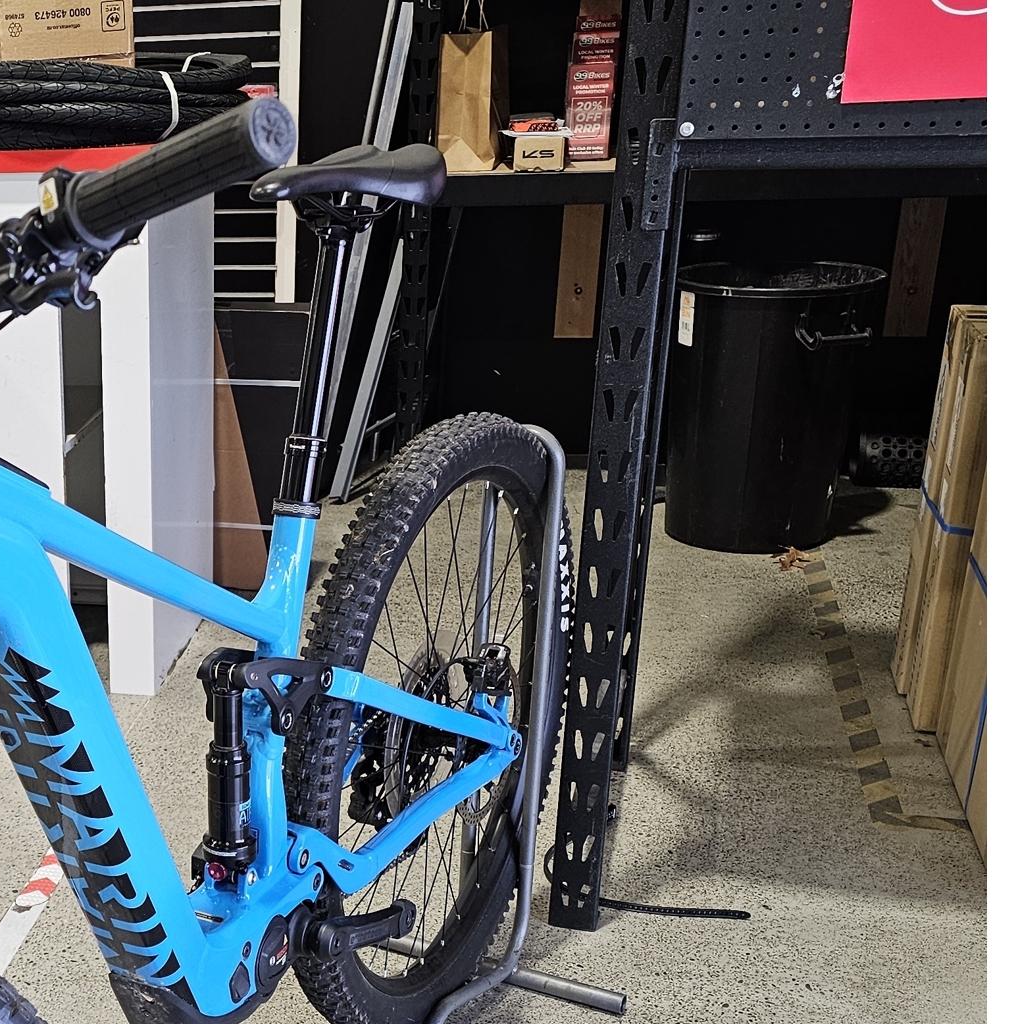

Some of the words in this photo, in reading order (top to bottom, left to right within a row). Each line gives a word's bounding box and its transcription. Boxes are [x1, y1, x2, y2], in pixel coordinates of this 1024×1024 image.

[34, 8, 67, 20] 426473
[69, 7, 91, 18] 0800
[576, 101, 603, 111] 20%
[576, 112, 602, 122] OFF
[574, 123, 601, 133] RRP
[522, 149, 555, 159] KS
[22, 726, 182, 988] MARIN
